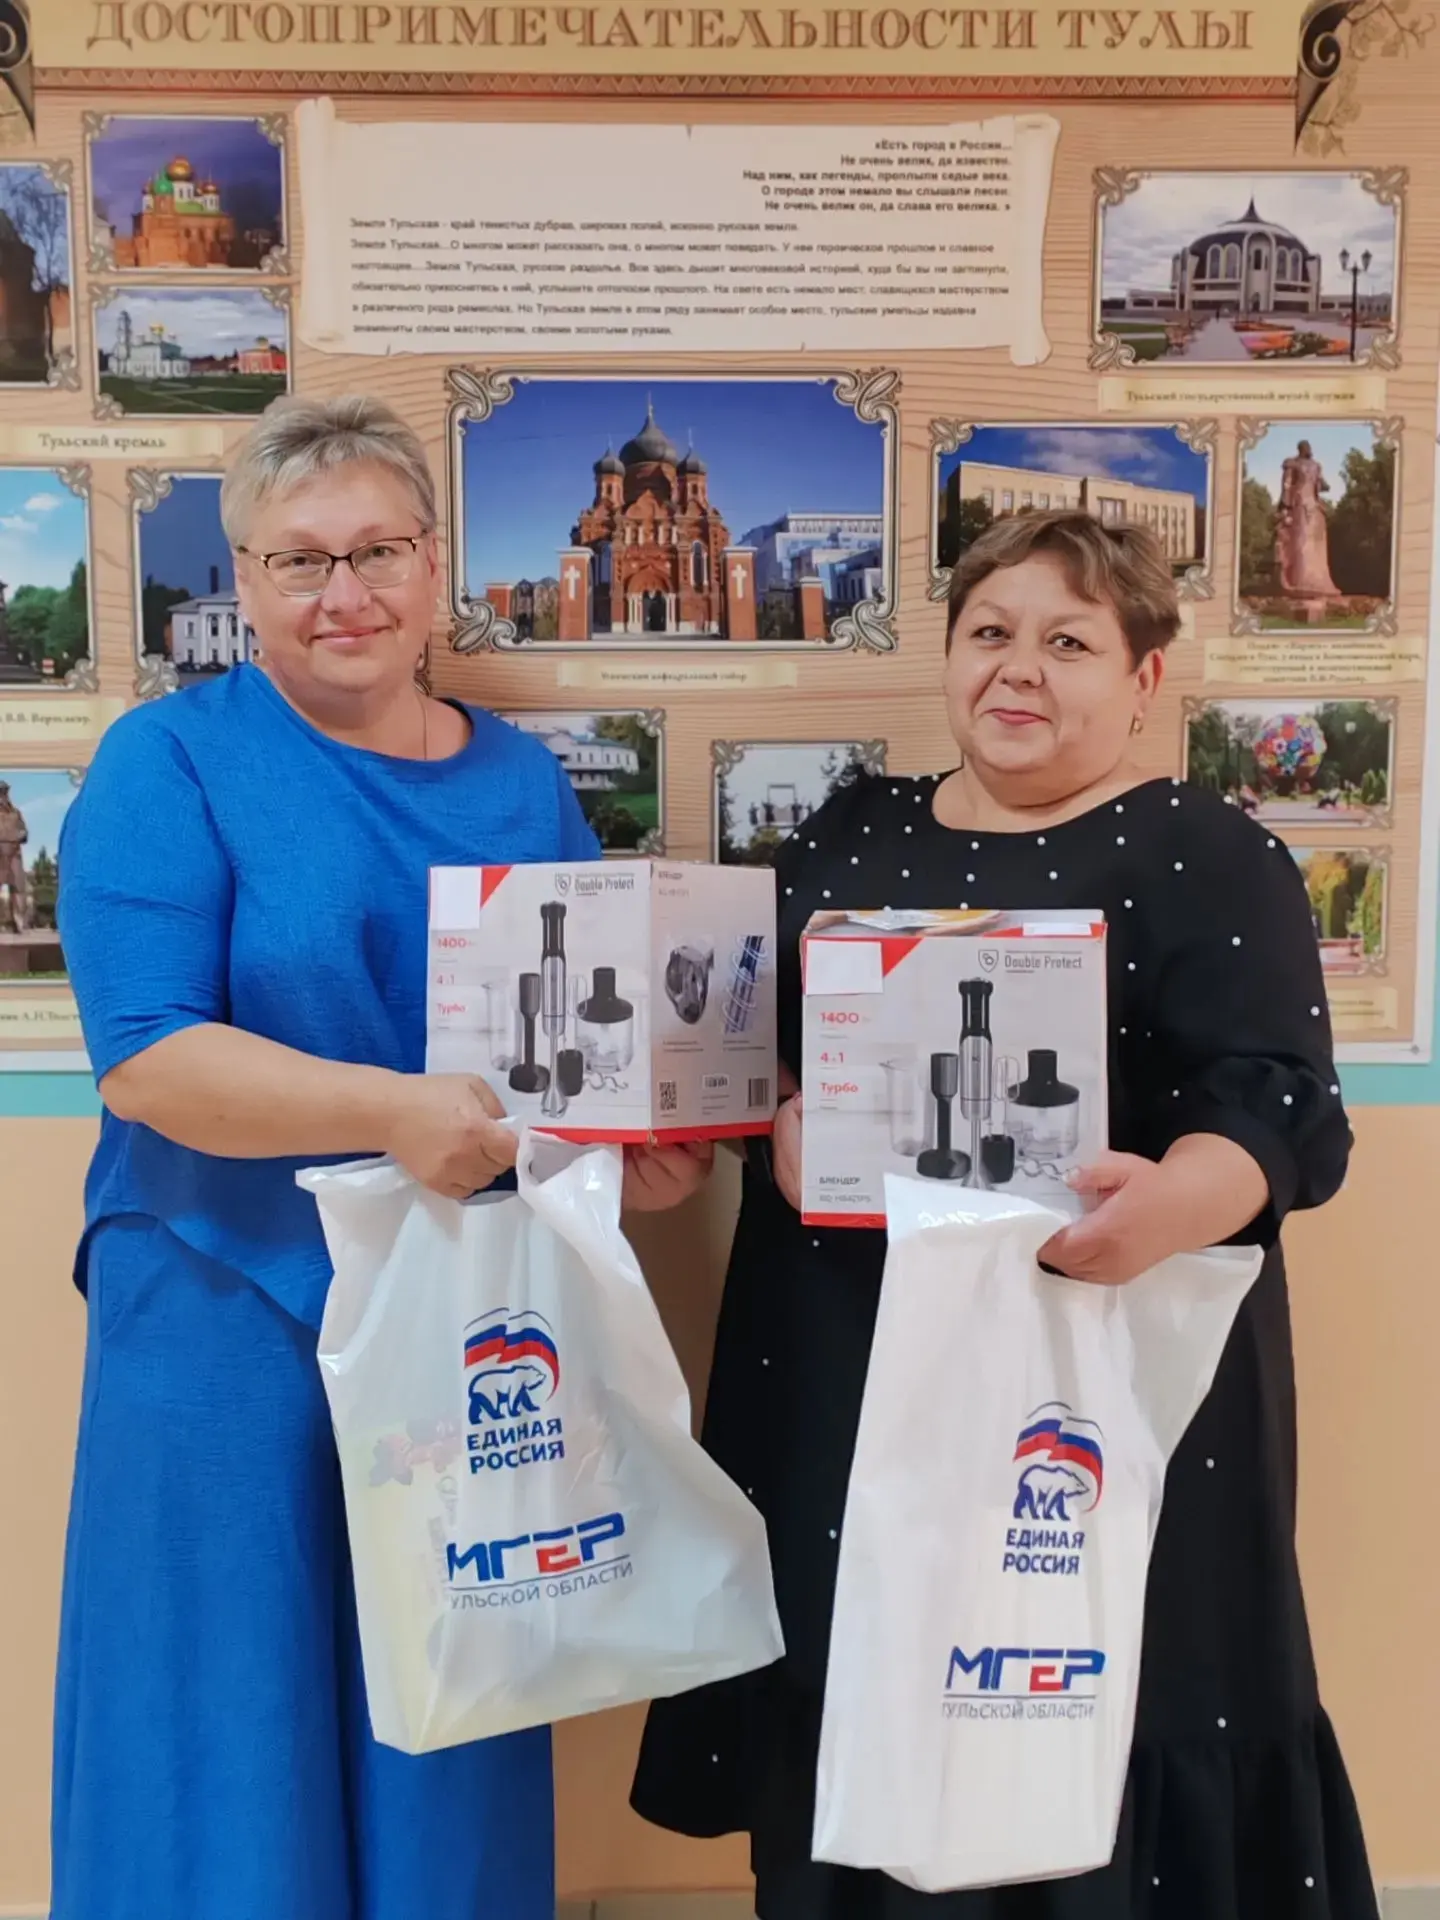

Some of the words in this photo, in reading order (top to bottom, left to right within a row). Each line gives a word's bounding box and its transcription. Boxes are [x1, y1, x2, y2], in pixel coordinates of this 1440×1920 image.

[87, 1, 1038, 49] ДОСТОПРИМЕЧАТЕЛЬНОСТИ
[1057, 9, 1254, 49] ТУЛЫ
[38, 432, 109, 451] Тульский
[114, 435, 165, 452] кремль
[575, 879, 603, 892] Double
[605, 878, 634, 890] Protect
[437, 938, 466, 948] 1400
[1005, 955, 1040, 968] Double
[1044, 955, 1082, 969] Protect
[820, 1012, 859, 1024] 1400
[821, 1082, 858, 1096] Турбо
[467, 1418, 562, 1451] ЕДИНАЯ
[469, 1440, 565, 1474] РОССИЯ
[446, 1512, 625, 1582] МГЕР
[1006, 1528, 1085, 1549] ЕДИНАЯ
[1002, 1553, 1080, 1575] РОССИЯ
[449, 1584, 540, 1610] УЛЬСКОЙ
[546, 1562, 633, 1598] ОБЛАСТИ
[945, 1645, 1106, 1691] МГЕР
[1027, 1703, 1094, 1719] ОБЛАСТИ
